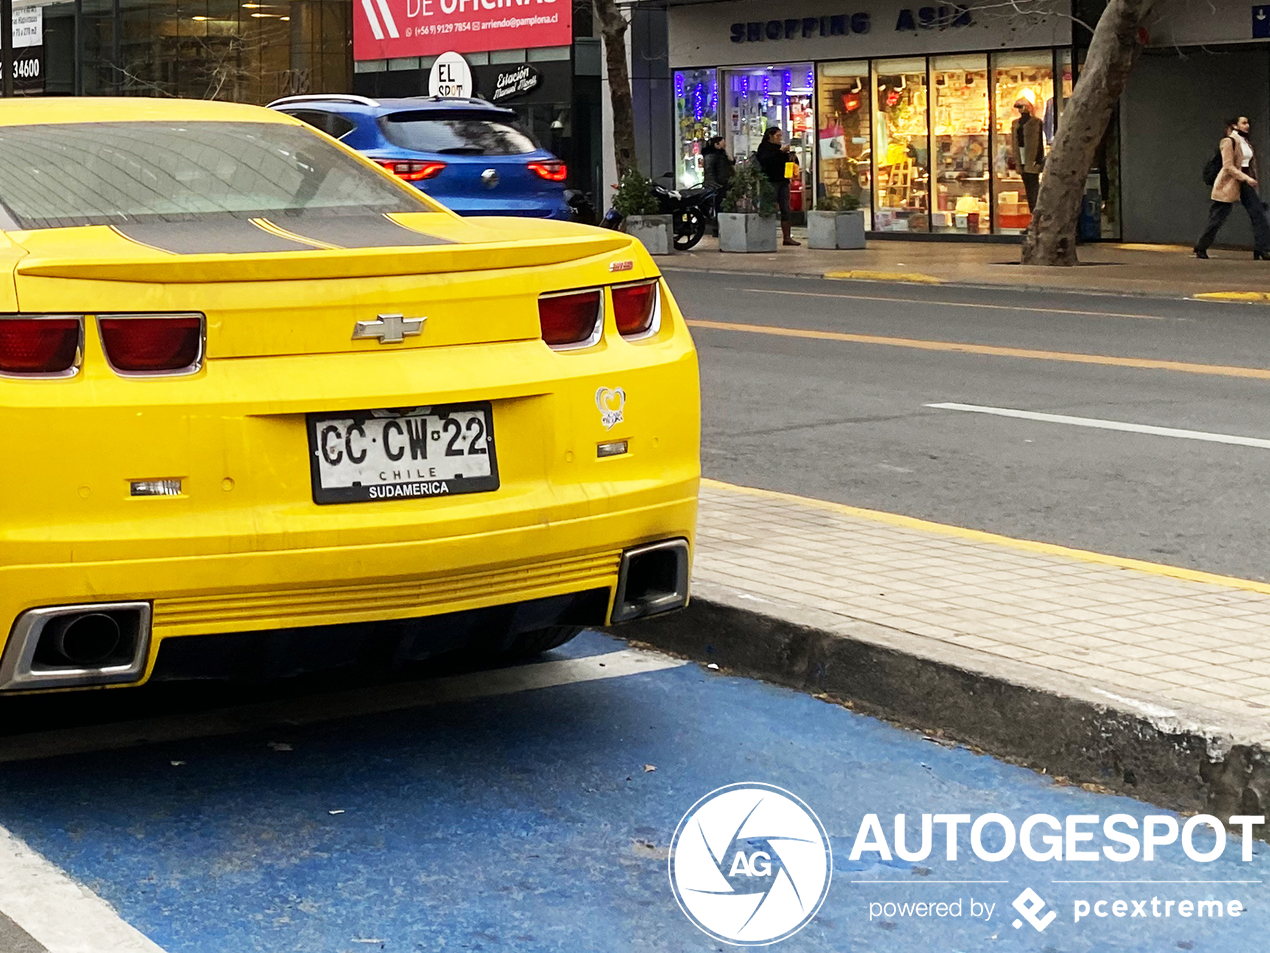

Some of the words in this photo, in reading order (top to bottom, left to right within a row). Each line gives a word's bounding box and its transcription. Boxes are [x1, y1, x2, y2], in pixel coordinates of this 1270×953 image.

[437, 23, 453, 34] 9129
[454, 22, 471, 33] 7854
[481, 13, 558, 30] arriendo@pamplona.cl
[730, 12, 872, 44] SHOPPING
[894, 3, 973, 32] ASIA
[438, 63, 456, 83] EL
[497, 65, 529, 88] Estación
[379, 467, 437, 481] CHILE
[368, 481, 449, 499] SUDAMERICA
